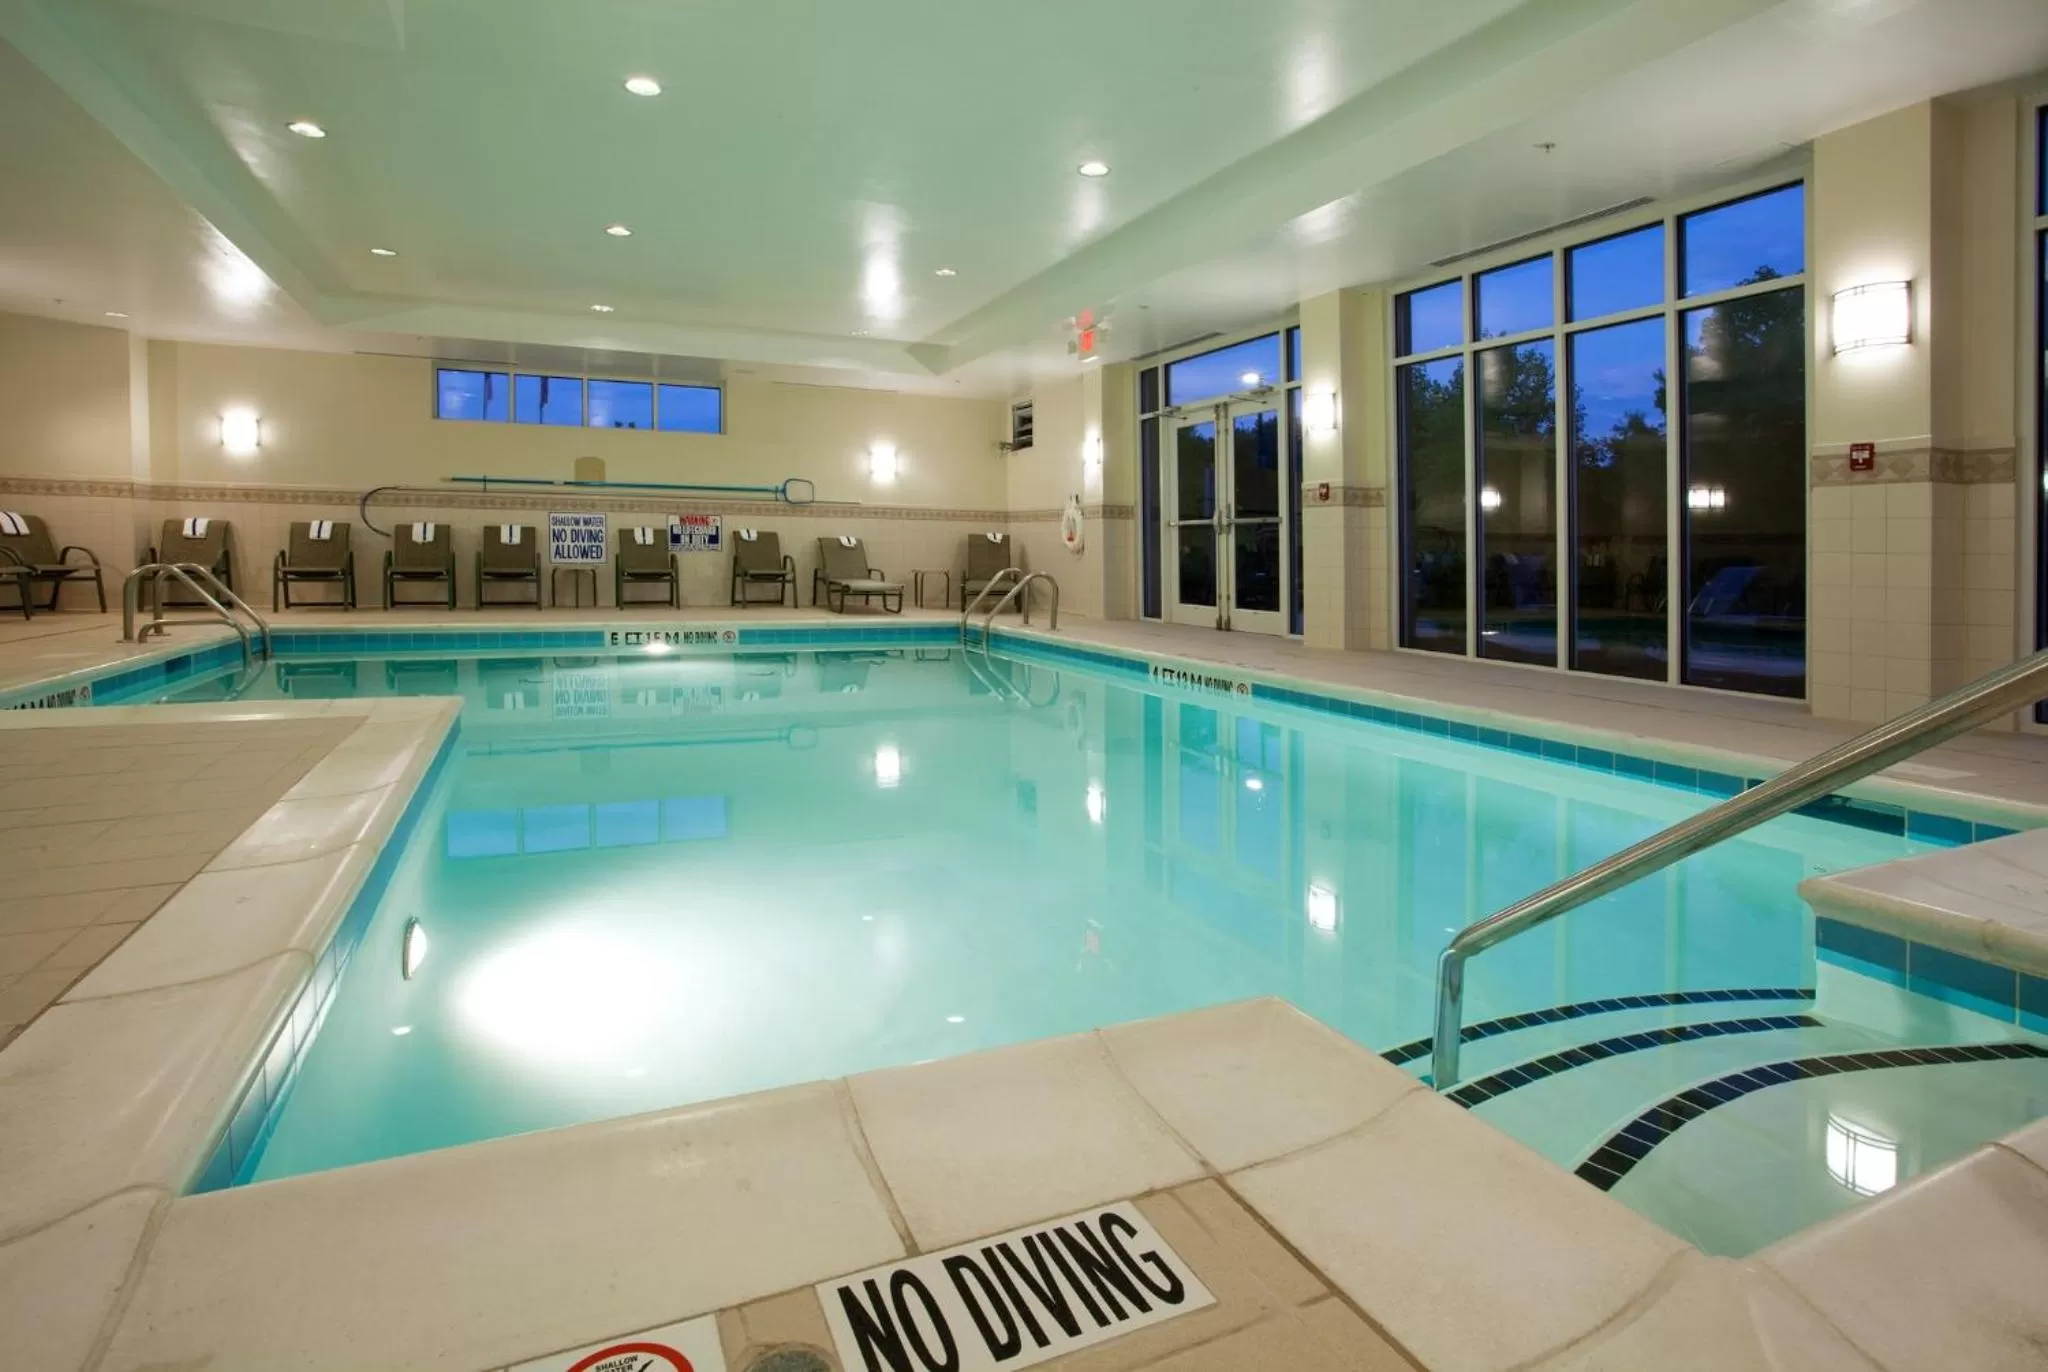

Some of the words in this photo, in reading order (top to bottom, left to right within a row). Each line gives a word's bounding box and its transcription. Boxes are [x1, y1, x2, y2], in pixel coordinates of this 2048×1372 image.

[551, 515, 581, 527] SHALLOW
[582, 516, 604, 527] WATER
[552, 528, 567, 543] NO
[570, 528, 604, 543] DIVING
[554, 544, 603, 559] ALLOWED
[837, 1268, 960, 1372] NO
[941, 1212, 1185, 1362] DIVING
[595, 1355, 638, 1372] SHALLOW
